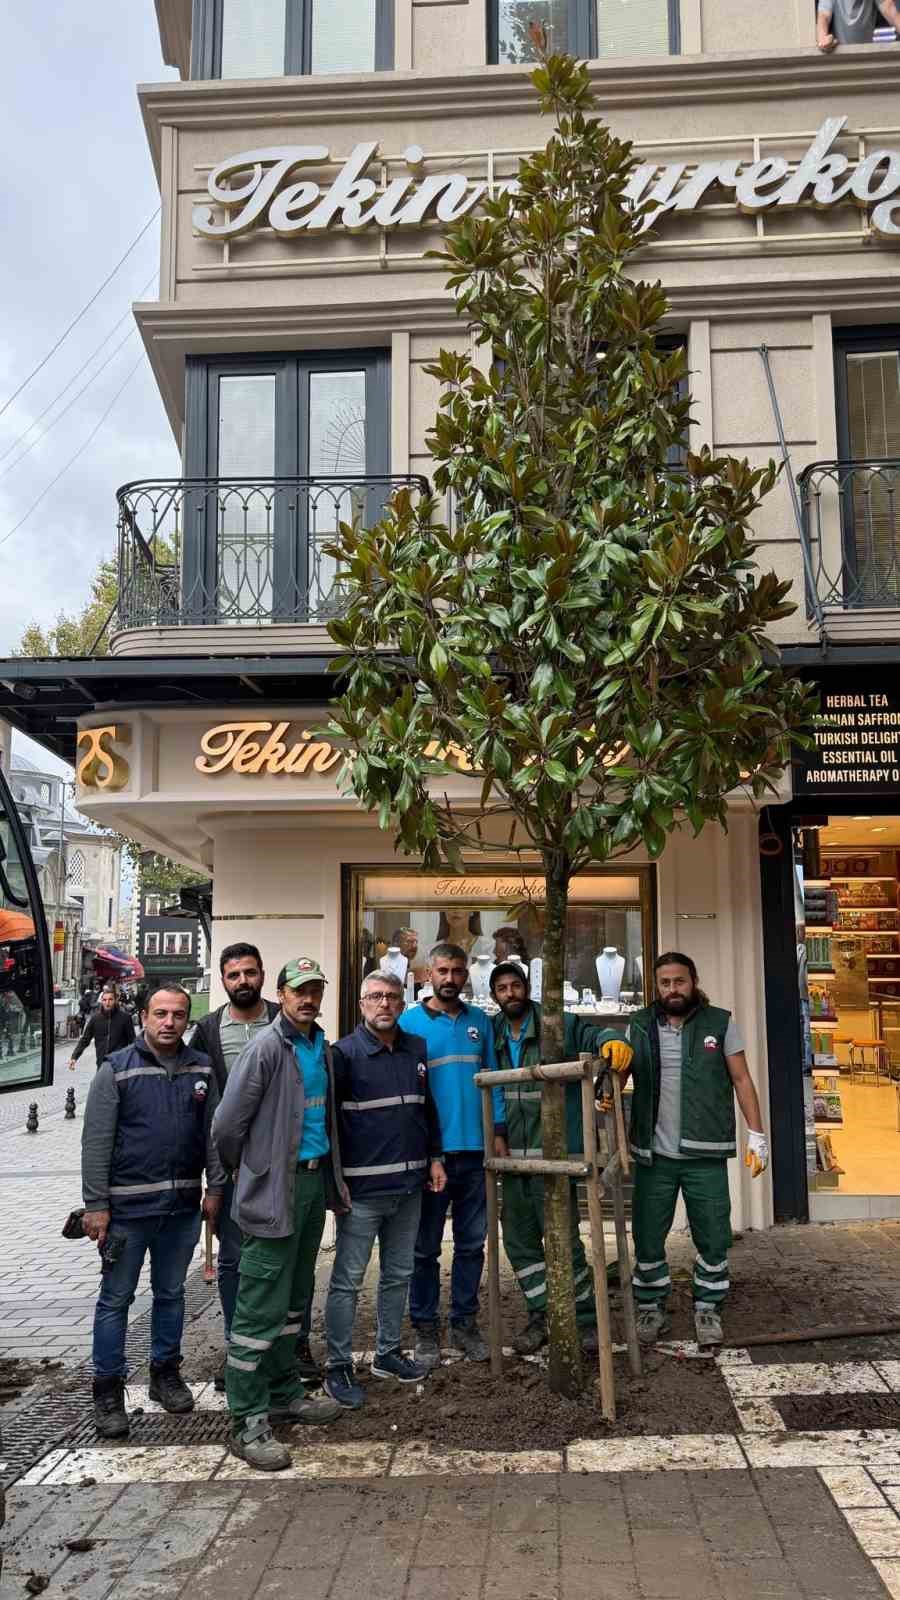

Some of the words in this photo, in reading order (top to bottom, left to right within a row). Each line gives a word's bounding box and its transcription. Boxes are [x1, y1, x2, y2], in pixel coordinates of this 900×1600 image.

[191, 140, 487, 236] Tekin
[505, 115, 900, 236] yreko
[826, 695, 866, 708] HERBAL
[869, 694, 888, 706] TEA
[813, 732, 858, 745] TURKISH
[195, 722, 341, 774] Tekin
[823, 751, 878, 764] ESSENTIAL
[880, 750, 898, 763] OIL
[806, 770, 889, 783] AROMATHERAPY
